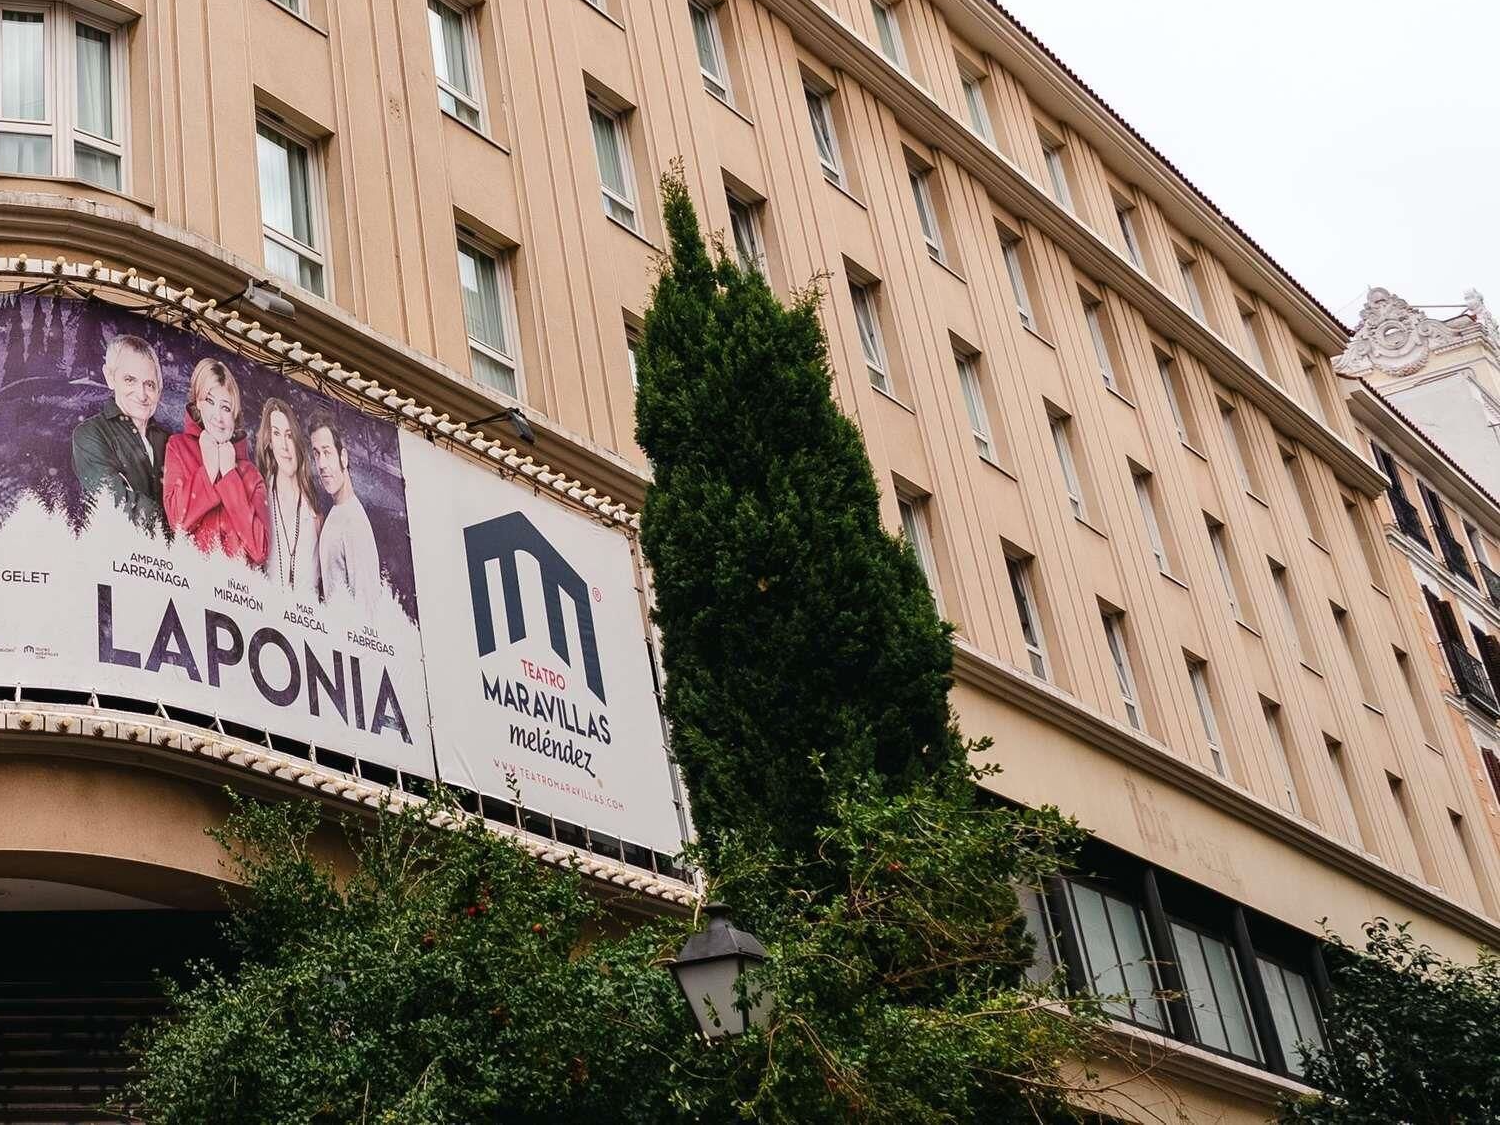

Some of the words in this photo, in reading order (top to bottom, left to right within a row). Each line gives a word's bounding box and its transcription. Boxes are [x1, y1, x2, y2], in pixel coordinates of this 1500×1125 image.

[112, 560, 190, 589] LARRAÑAGA
[130, 552, 174, 571] AMPARO
[227, 578, 249, 594] IÑAKI
[283, 610, 328, 635] ABASCAL
[296, 603, 314, 617] MAR
[97, 583, 413, 746] LAPONIA
[521, 658, 566, 691] TEATRO
[481, 668, 612, 745] MARAVILLAS
[509, 724, 596, 778] meléndez
